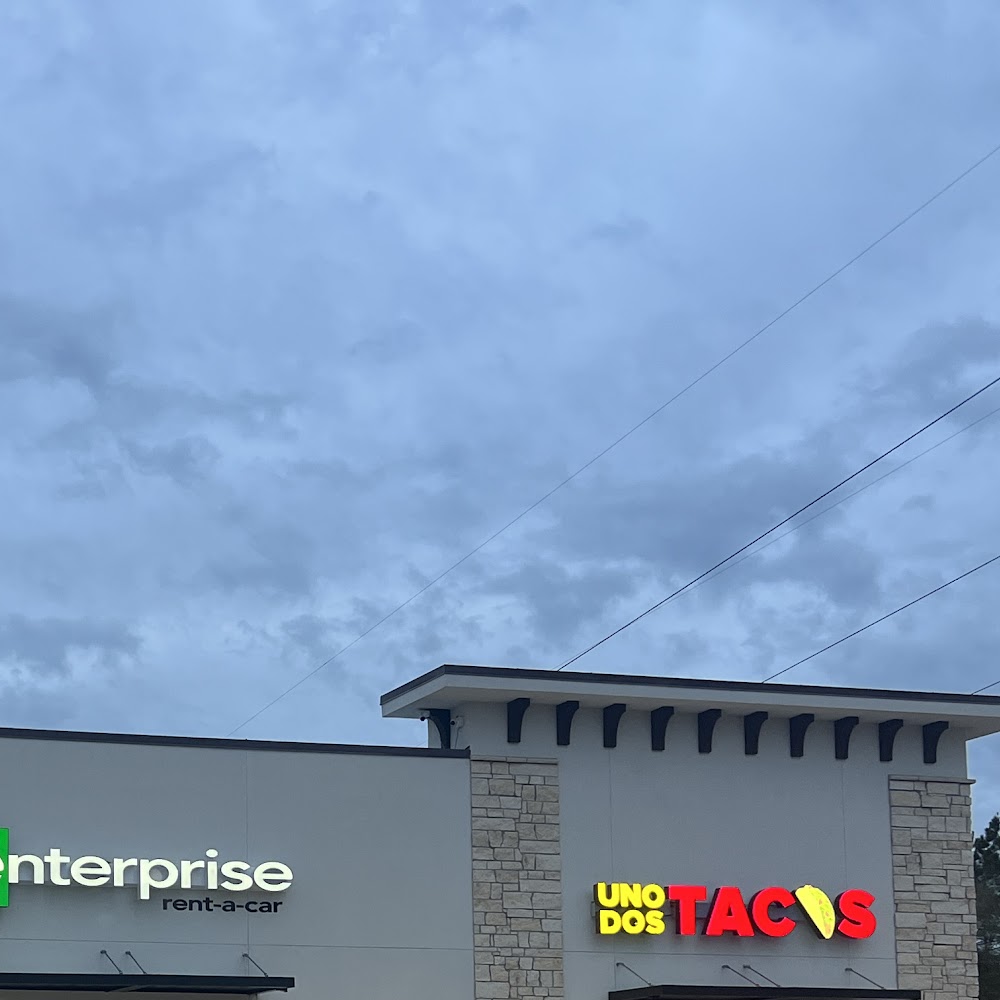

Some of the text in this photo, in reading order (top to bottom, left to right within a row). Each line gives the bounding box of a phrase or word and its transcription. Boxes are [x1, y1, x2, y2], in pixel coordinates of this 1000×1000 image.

[162, 896, 284, 914] rent-a-car
[597, 882, 666, 909] UNO
[599, 910, 666, 935] DOS
